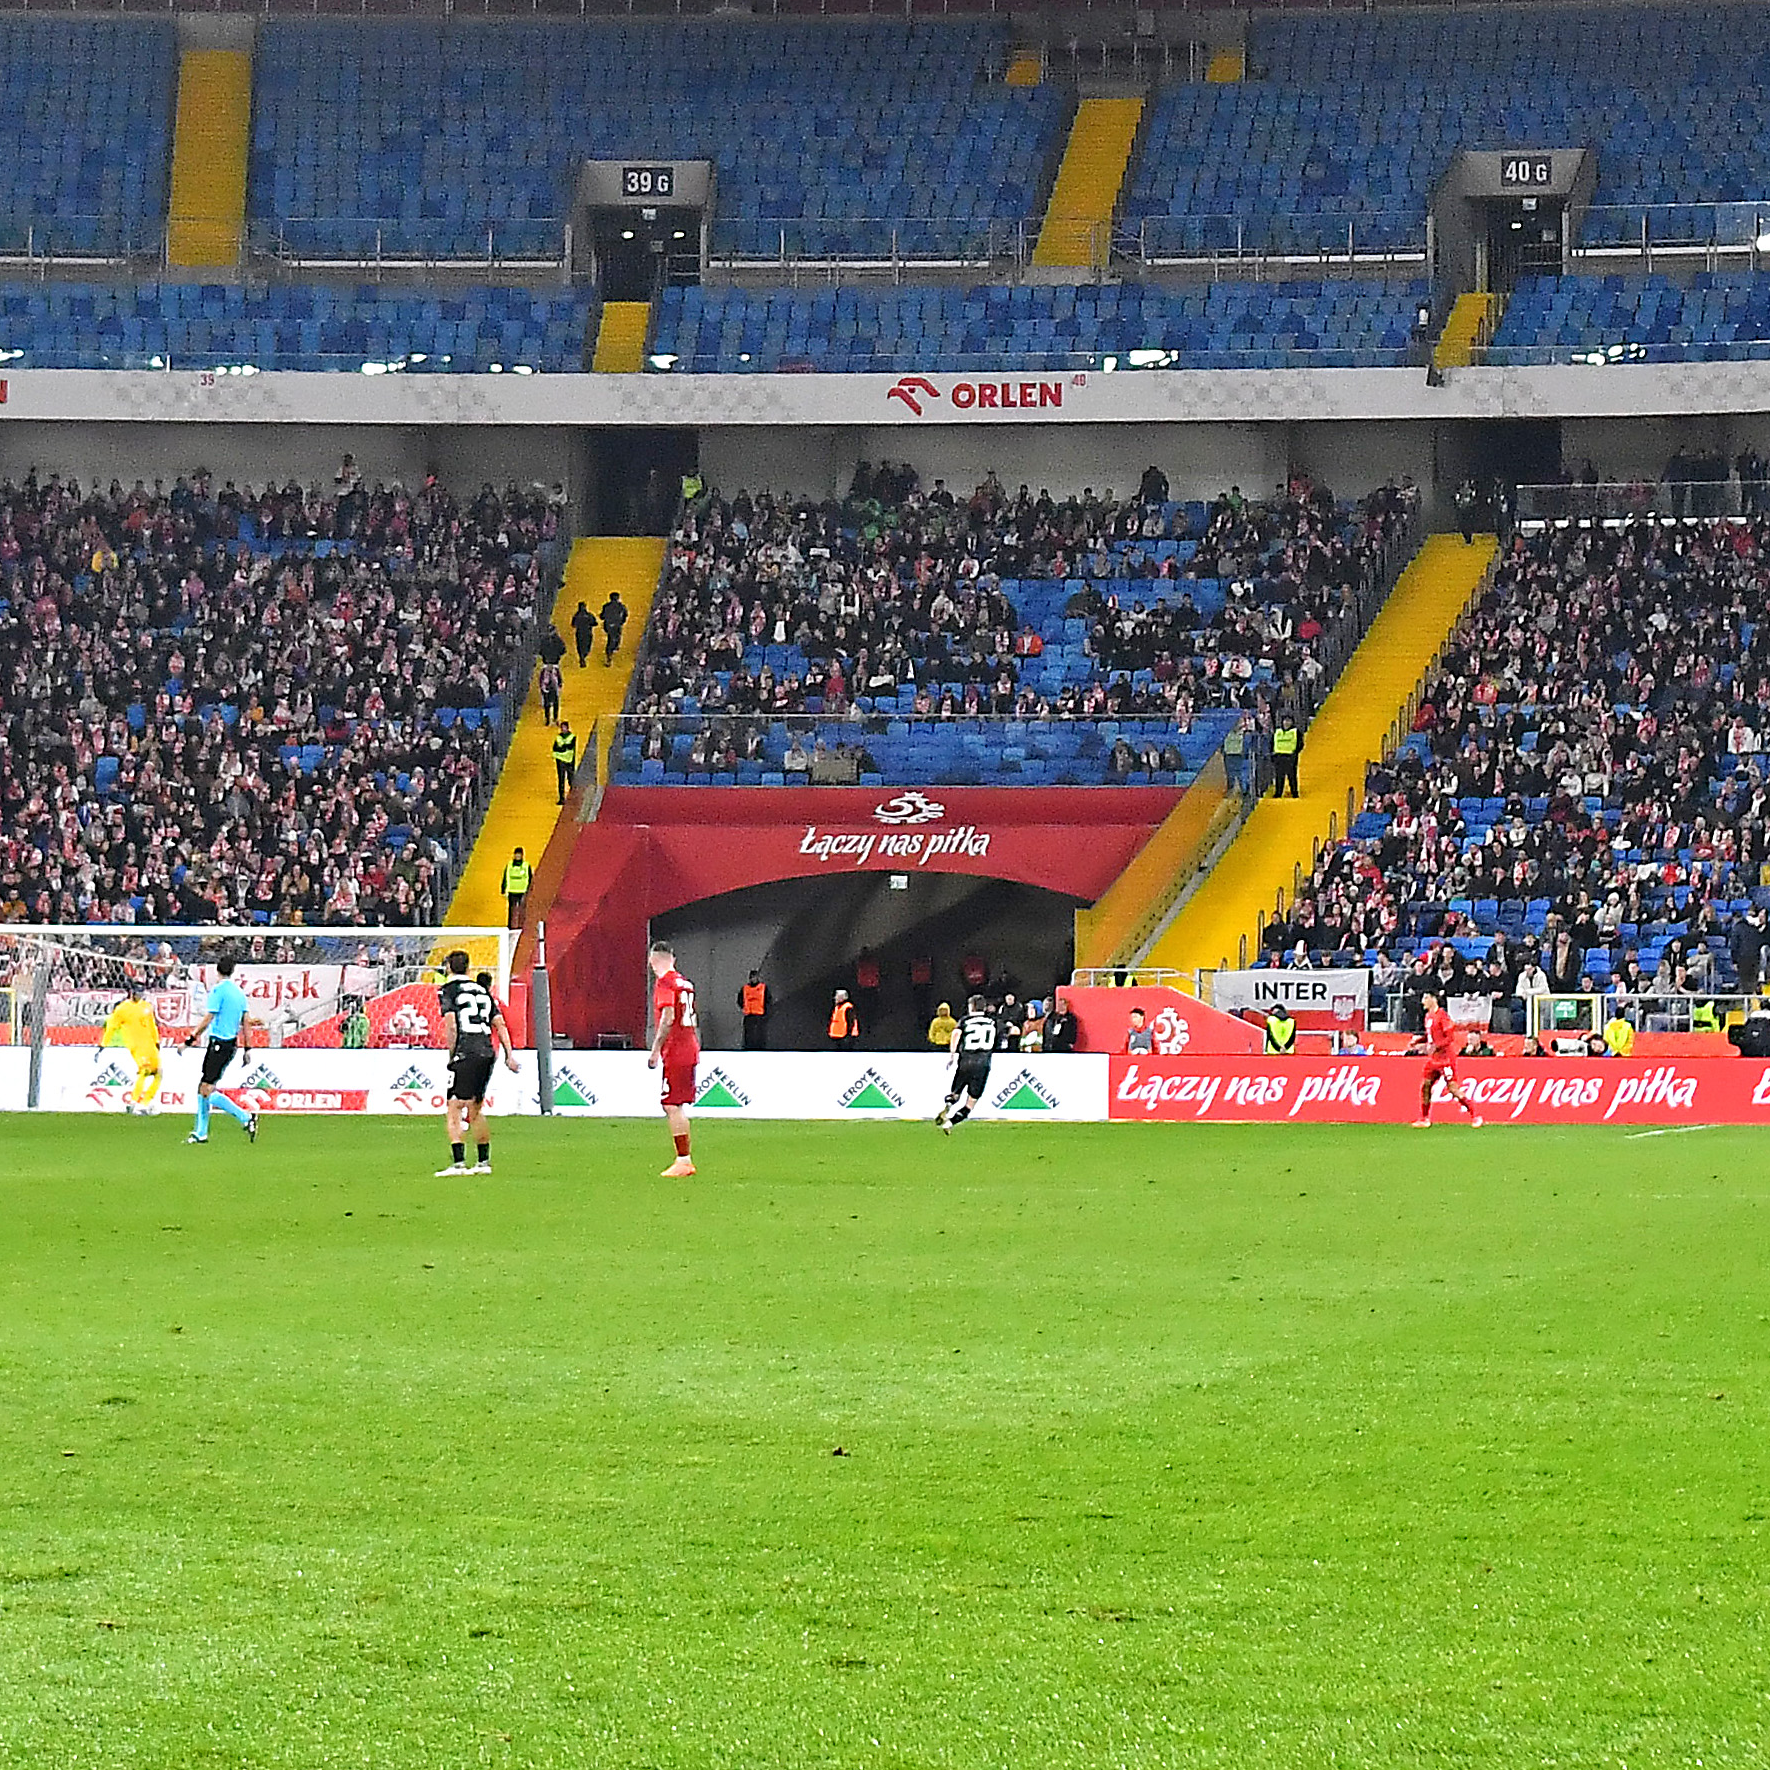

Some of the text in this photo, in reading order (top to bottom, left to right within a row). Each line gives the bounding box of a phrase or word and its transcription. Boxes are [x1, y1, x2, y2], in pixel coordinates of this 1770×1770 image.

[627, 171, 669, 192] 39 G
[1505, 161, 1547, 181] 40 G
[951, 382, 1063, 408] ORLEN
[799, 825, 991, 865] Łączy nas piłka
[1254, 982, 1327, 1000] INTER
[963, 1024, 997, 1050] 20
[121, 1091, 186, 1106] OEN
[278, 1092, 343, 1109] ORLEN
[560, 1065, 600, 1106] MERLIN
[711, 1066, 752, 1106] MERLIN
[836, 1066, 906, 1108] LEROY MERLIN
[991, 1068, 1060, 1110] LEROY MERLIN
[1117, 1065, 1382, 1117] Łączy nas piłka
[1538, 1076, 1603, 1107] nas
[1603, 1067, 1698, 1120] piłka
